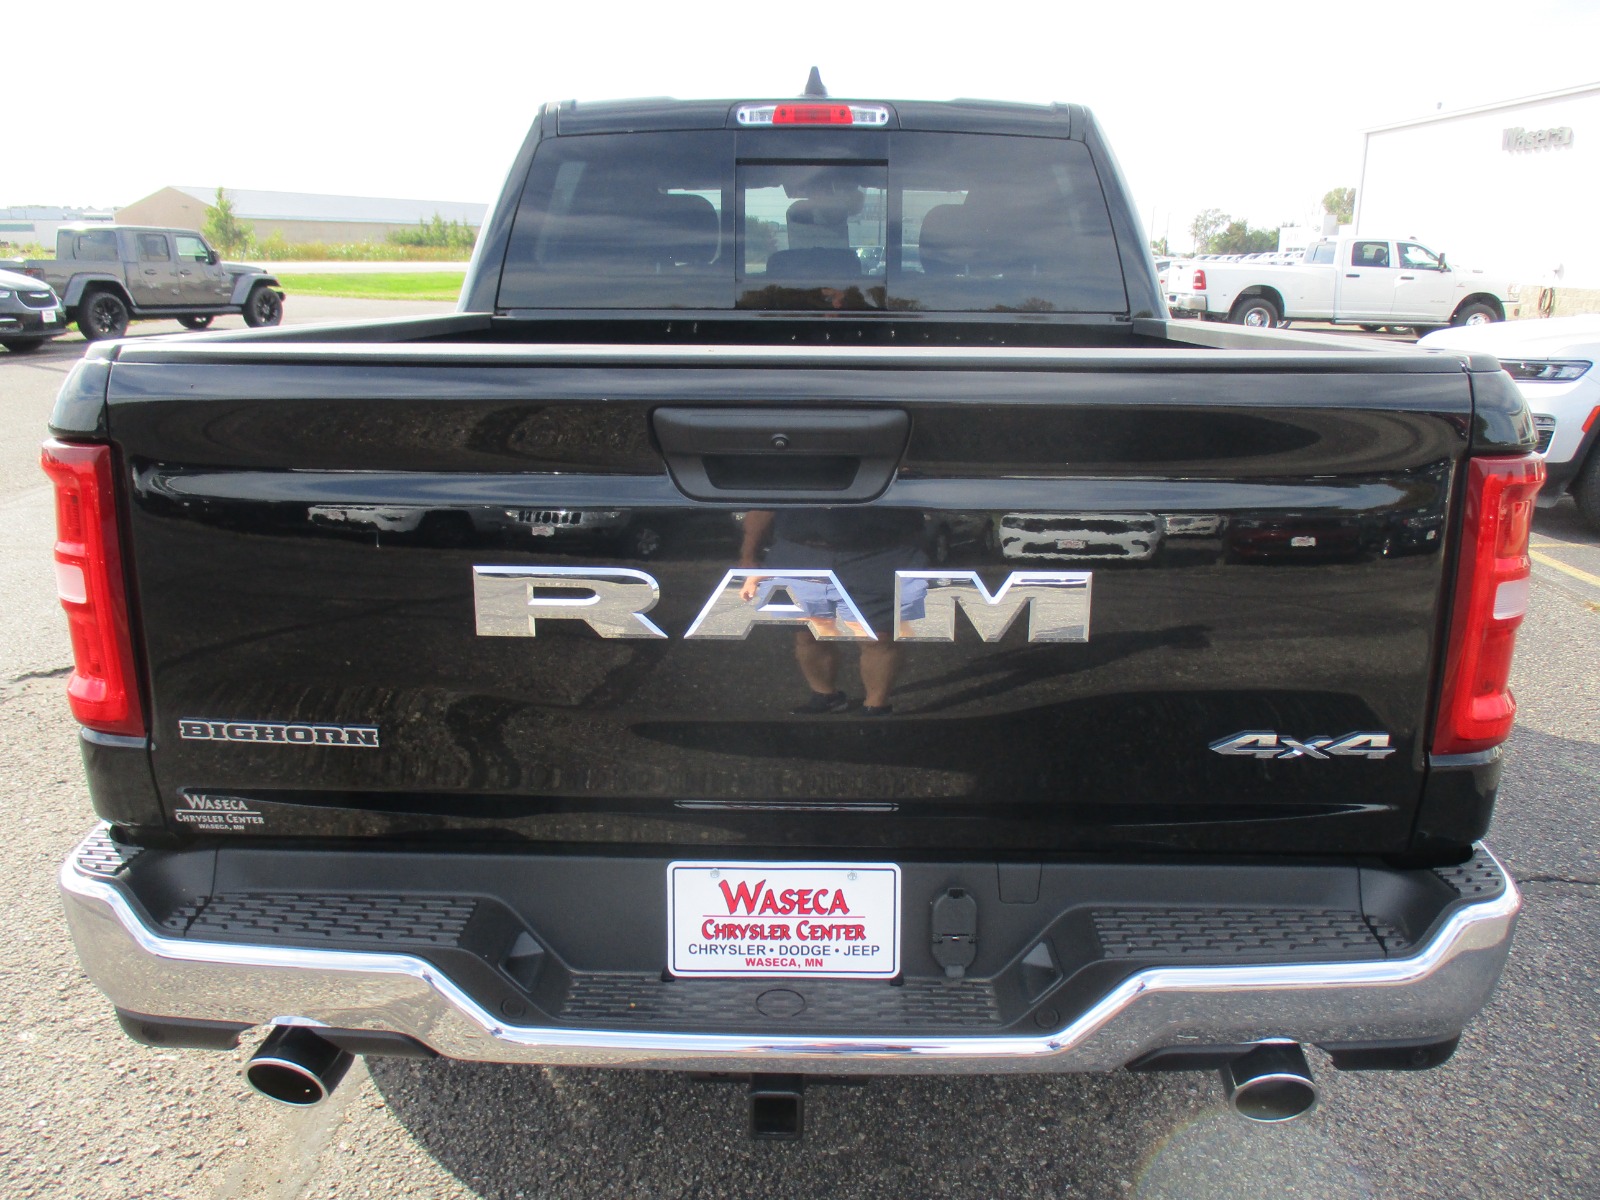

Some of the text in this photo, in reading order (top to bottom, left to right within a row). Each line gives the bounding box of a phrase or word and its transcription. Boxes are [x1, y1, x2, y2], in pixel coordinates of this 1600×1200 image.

[472, 565, 1093, 643] RAM
[178, 718, 380, 748] BIGHORN
[184, 794, 248, 811] WASECA
[175, 812, 265, 825] CHRYSLER CENTER
[718, 879, 850, 916] WASECA
[701, 919, 867, 942] CHRYSLER CENTER
[779, 945, 832, 956] DODGE
[843, 945, 880, 957] JEEP
[745, 957, 824, 968] WASECA, MN
